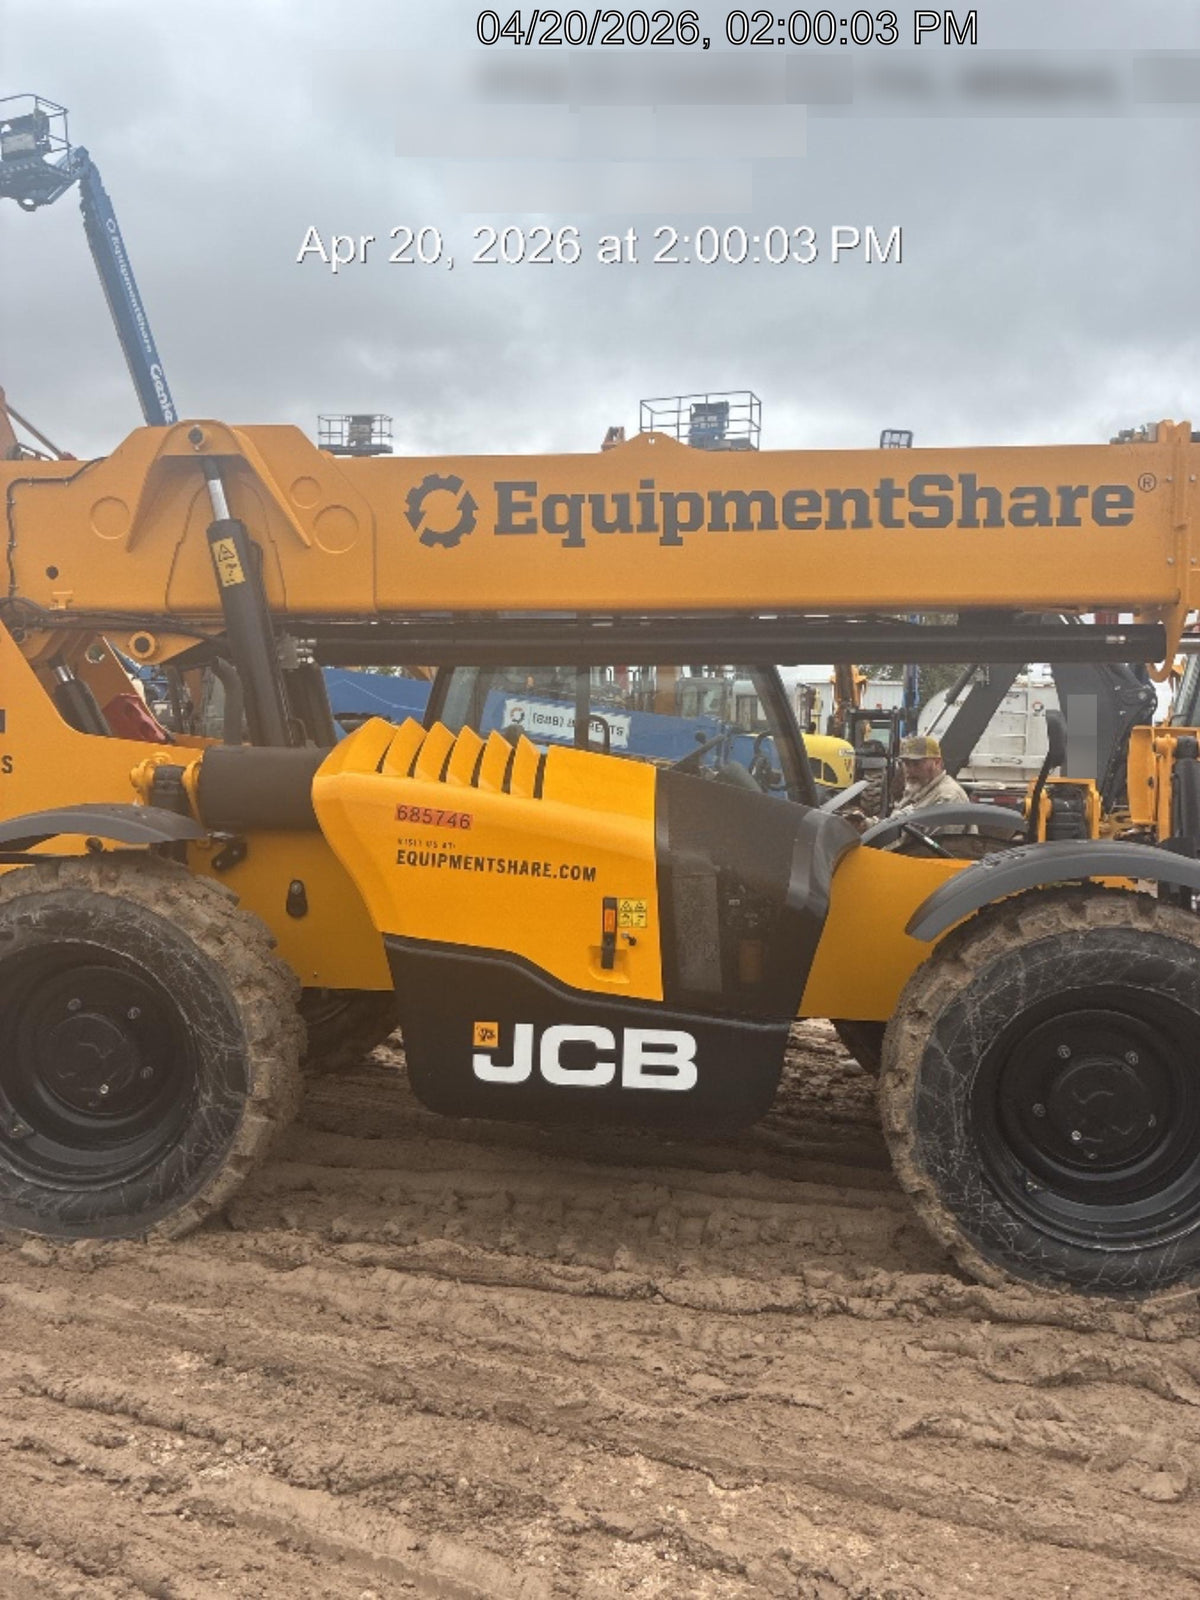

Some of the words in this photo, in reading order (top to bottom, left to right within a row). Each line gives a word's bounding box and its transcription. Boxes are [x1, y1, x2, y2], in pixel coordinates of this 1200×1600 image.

[150, 363, 175, 425] Genie
[397, 805, 471, 831] 685746
[396, 849, 597, 882] EQUIPMENTSHARE.COM
[472, 1022, 699, 1092] JCB
